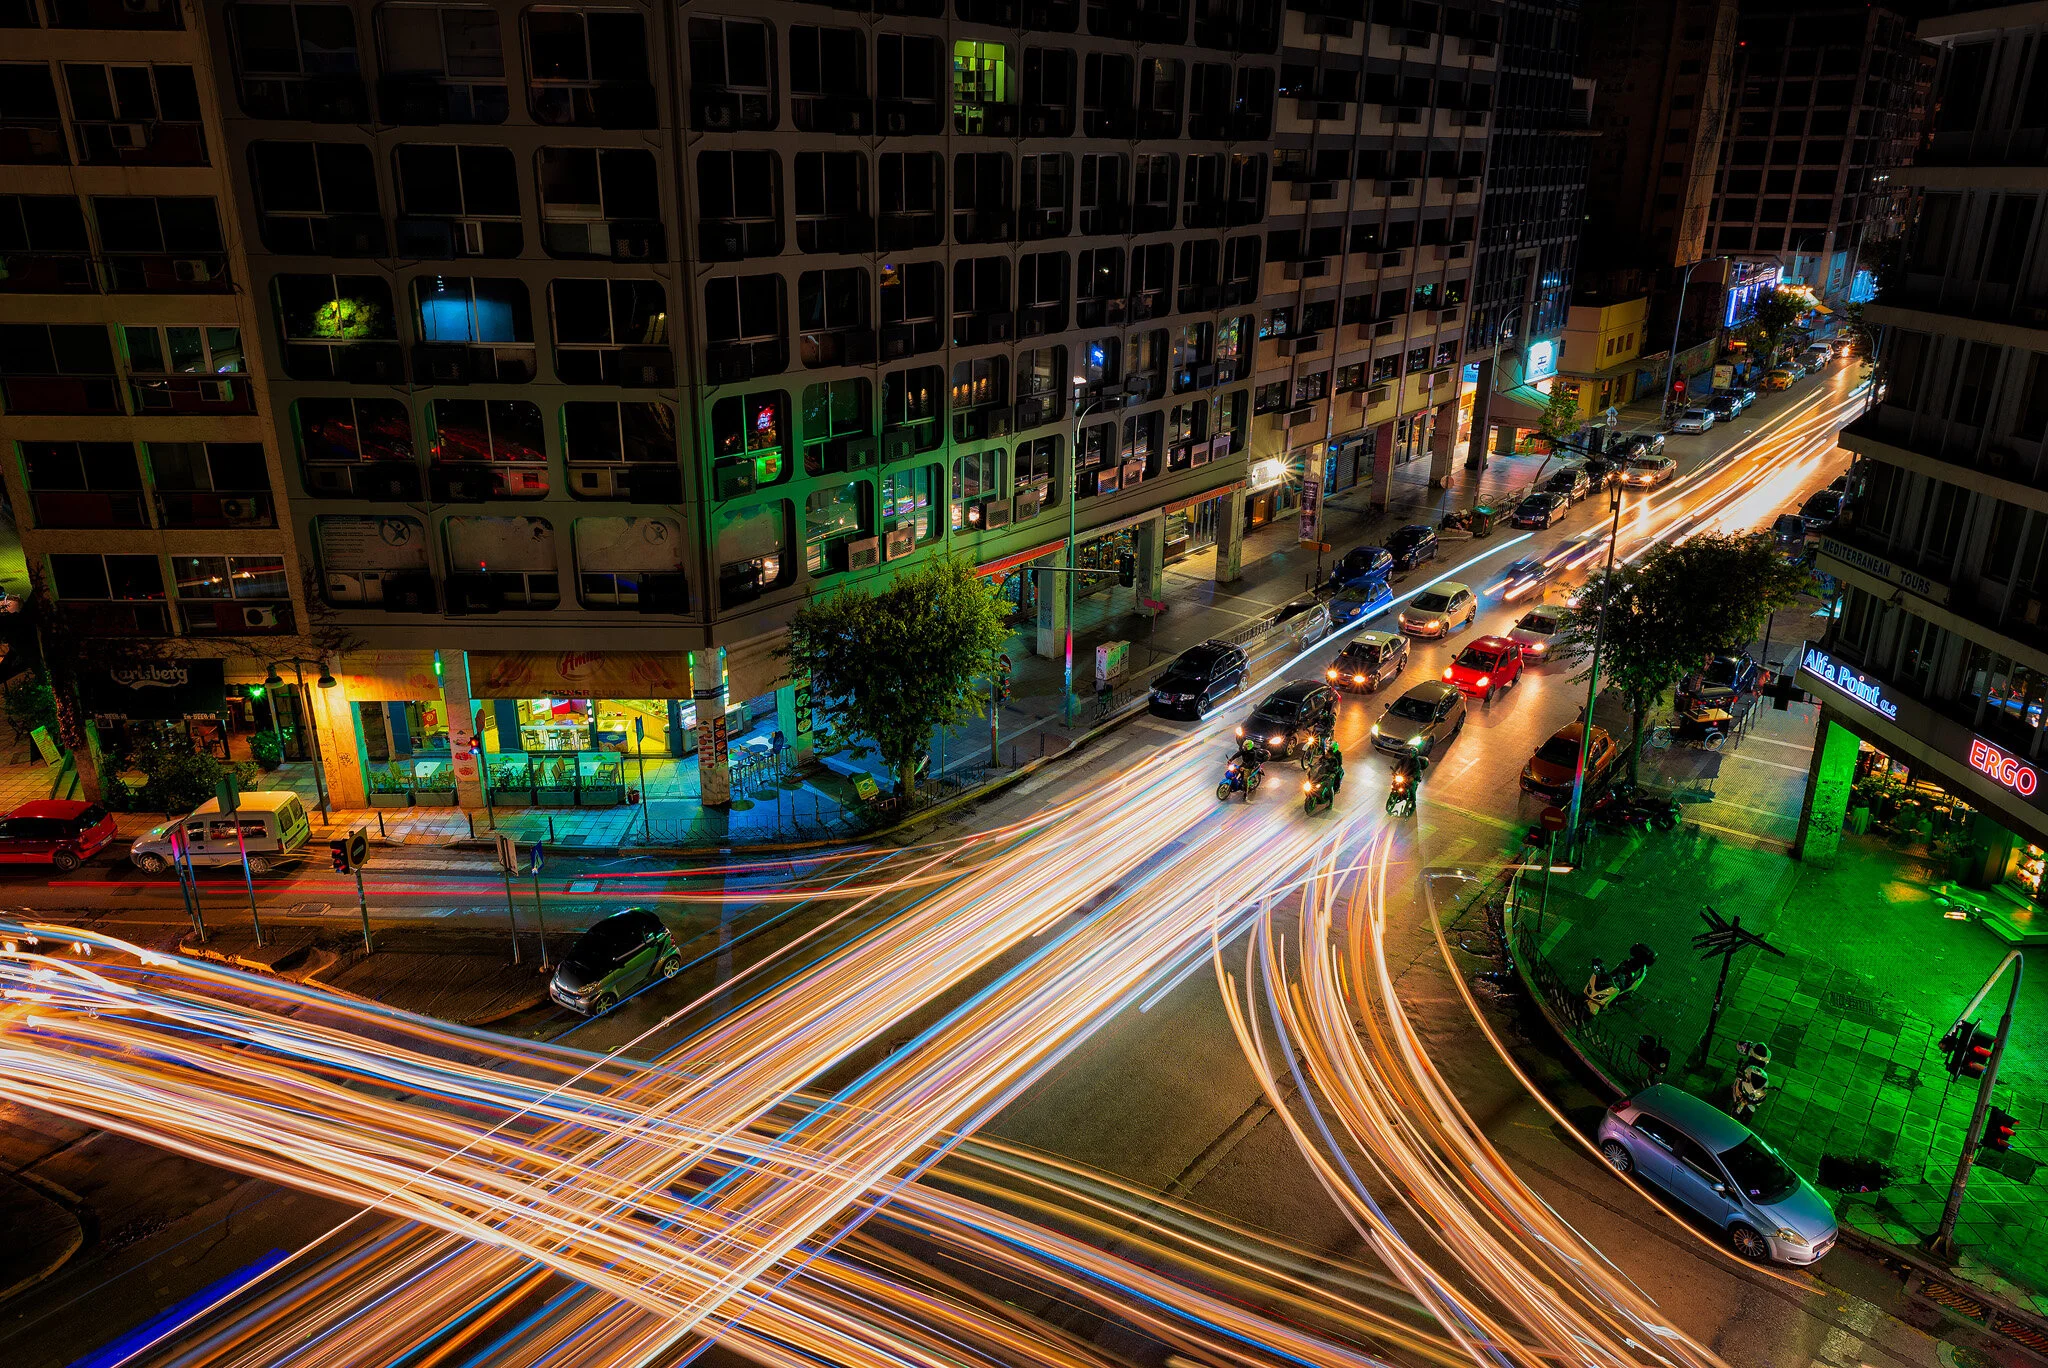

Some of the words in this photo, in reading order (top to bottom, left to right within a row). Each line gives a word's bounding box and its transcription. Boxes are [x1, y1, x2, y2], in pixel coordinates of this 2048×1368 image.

[1823, 540, 1890, 577] MEDITERRANEAN
[1900, 571, 1930, 595] TOURS
[110, 663, 189, 687] Carlsberg
[1803, 648, 1836, 680] Alfa
[1838, 666, 1880, 707] Point
[1969, 738, 2038, 797] ERGO
